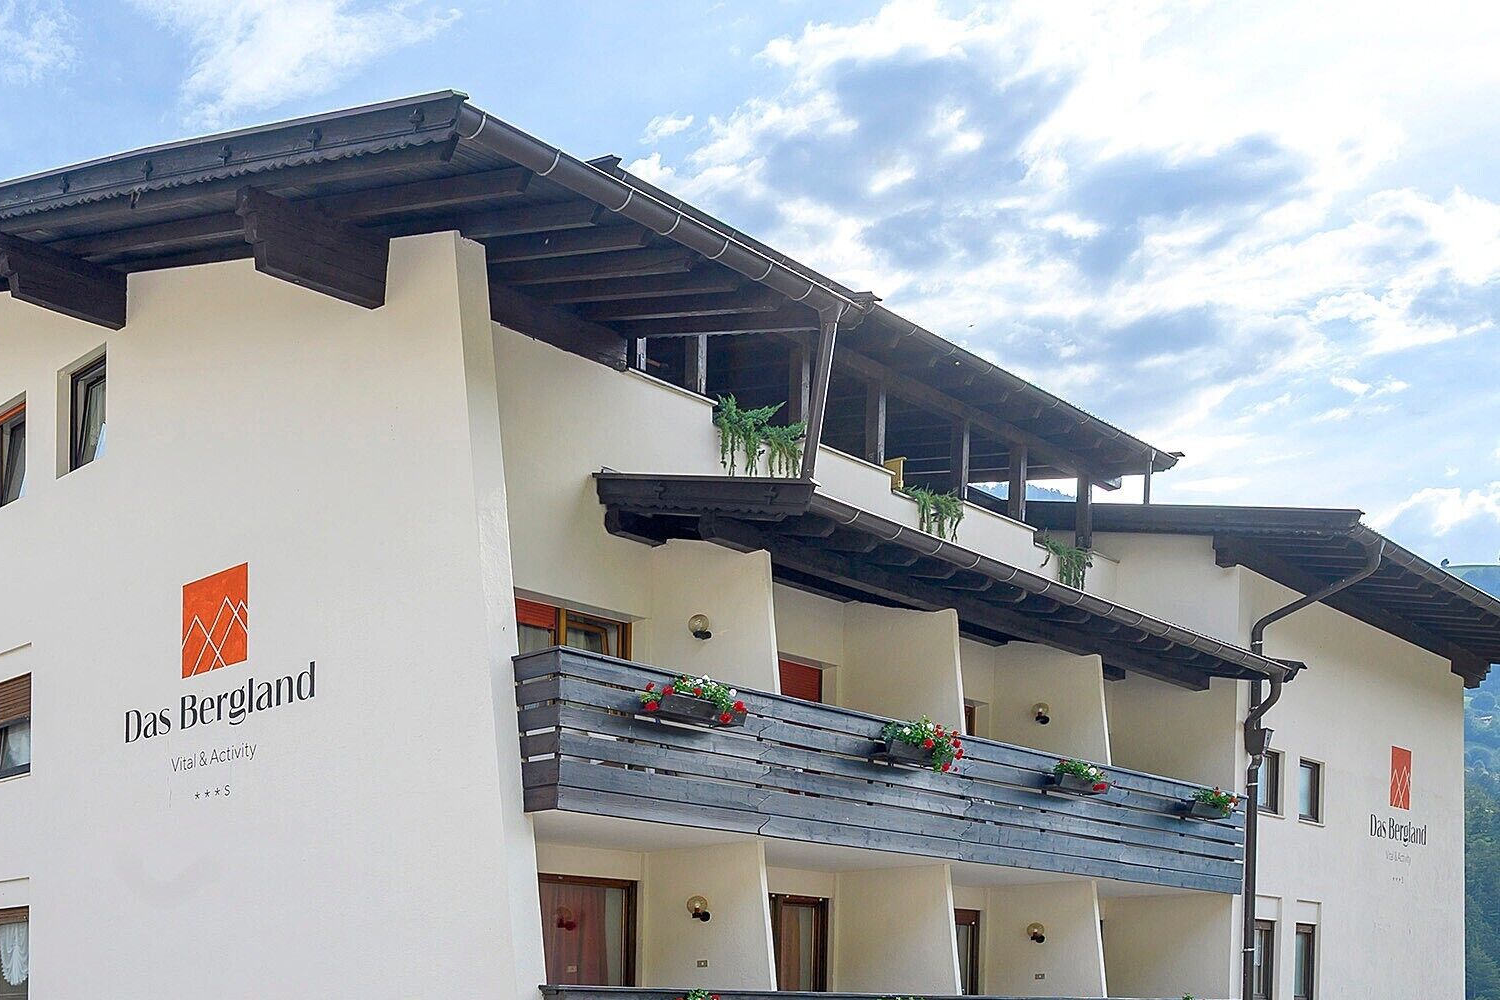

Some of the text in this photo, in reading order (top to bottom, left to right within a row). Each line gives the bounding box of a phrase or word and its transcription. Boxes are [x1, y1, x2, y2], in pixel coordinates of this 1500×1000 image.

[125, 660, 316, 744] Das Bergland
[171, 742, 257, 773] Vital & Activity
[1370, 813, 1427, 847] Das Bergland
